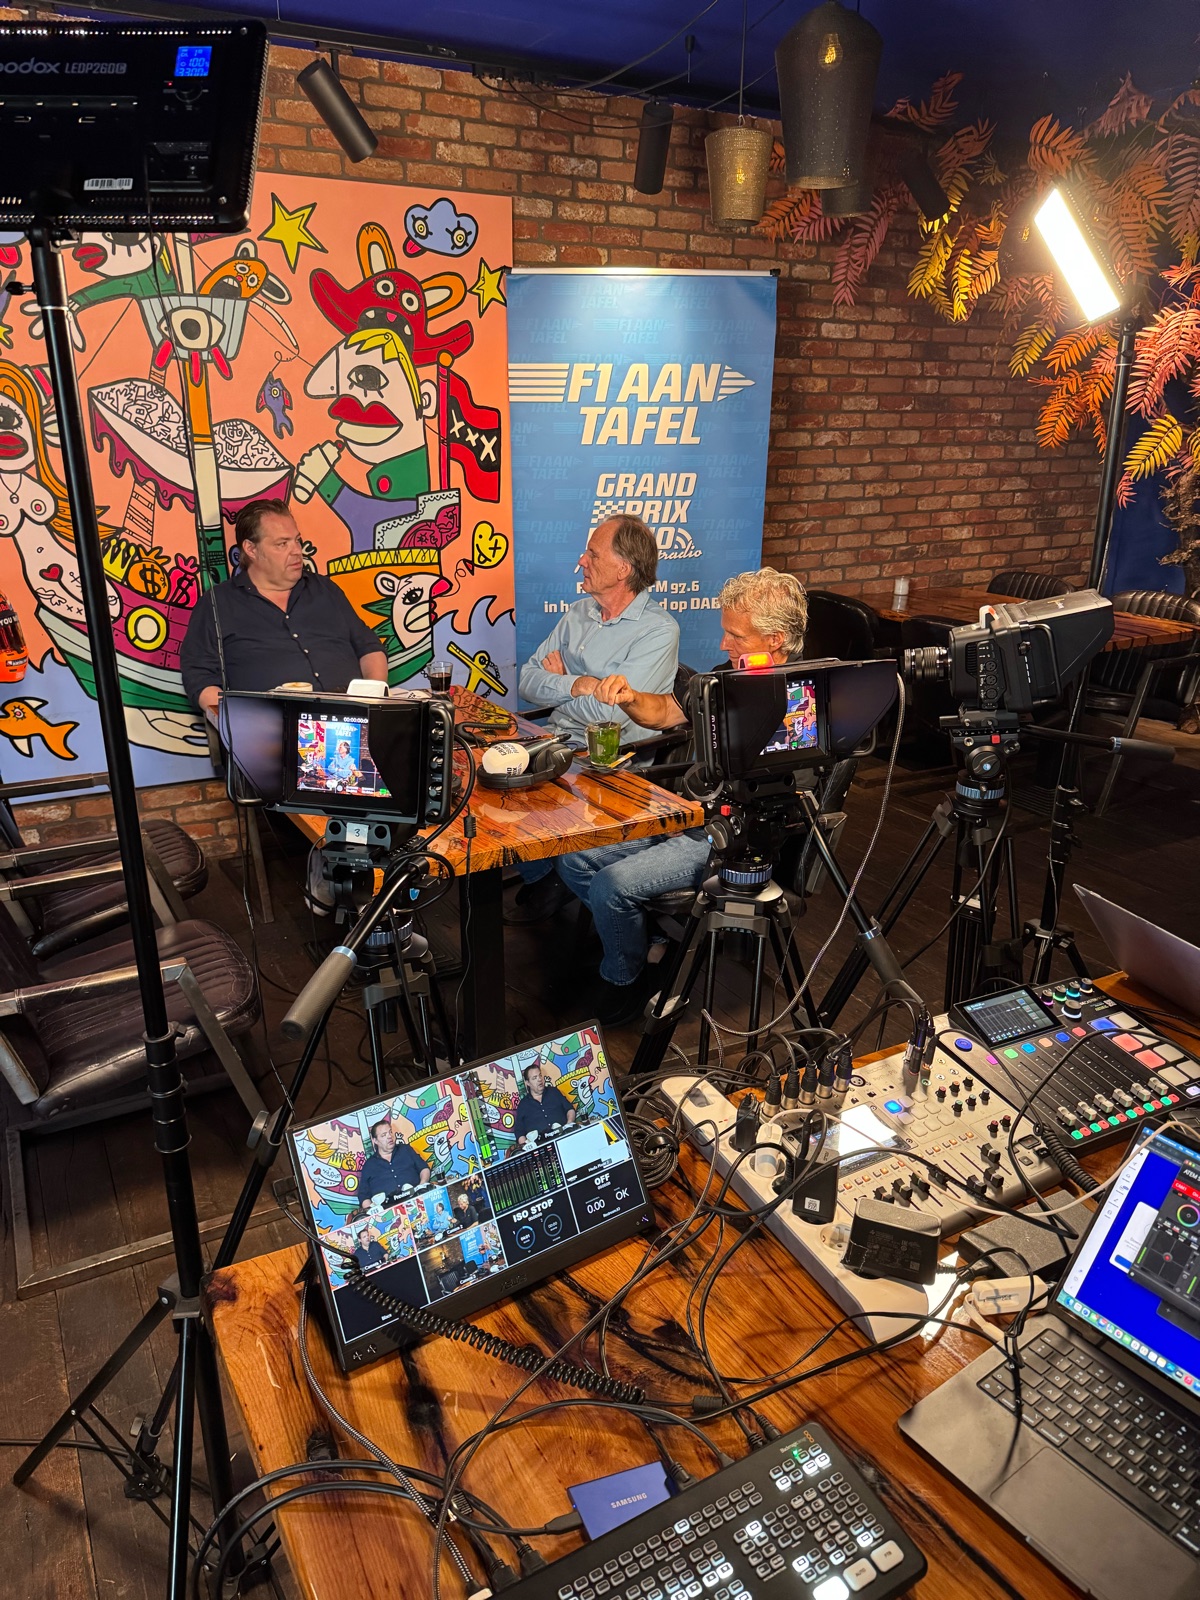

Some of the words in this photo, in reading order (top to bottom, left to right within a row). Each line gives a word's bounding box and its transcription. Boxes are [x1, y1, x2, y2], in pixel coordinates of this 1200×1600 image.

[0, 57, 60, 74] odox
[567, 364, 614, 403] F1
[616, 364, 722, 403] AAN
[579, 406, 701, 445] TAFEL
[596, 473, 698, 497] GRAND
[625, 500, 692, 524] PRIX
[670, 581, 700, 594] 97.6
[544, 600, 558, 613] in
[670, 600, 688, 613] op
[354, 828, 361, 838] 3
[594, 1173, 610, 1186] OFF
[615, 1187, 630, 1201] OK
[512, 1209, 529, 1223] ISO
[530, 1199, 554, 1215] STOP
[587, 1199, 606, 1214] 0.00
[610, 1492, 648, 1509] SAMSUNG
